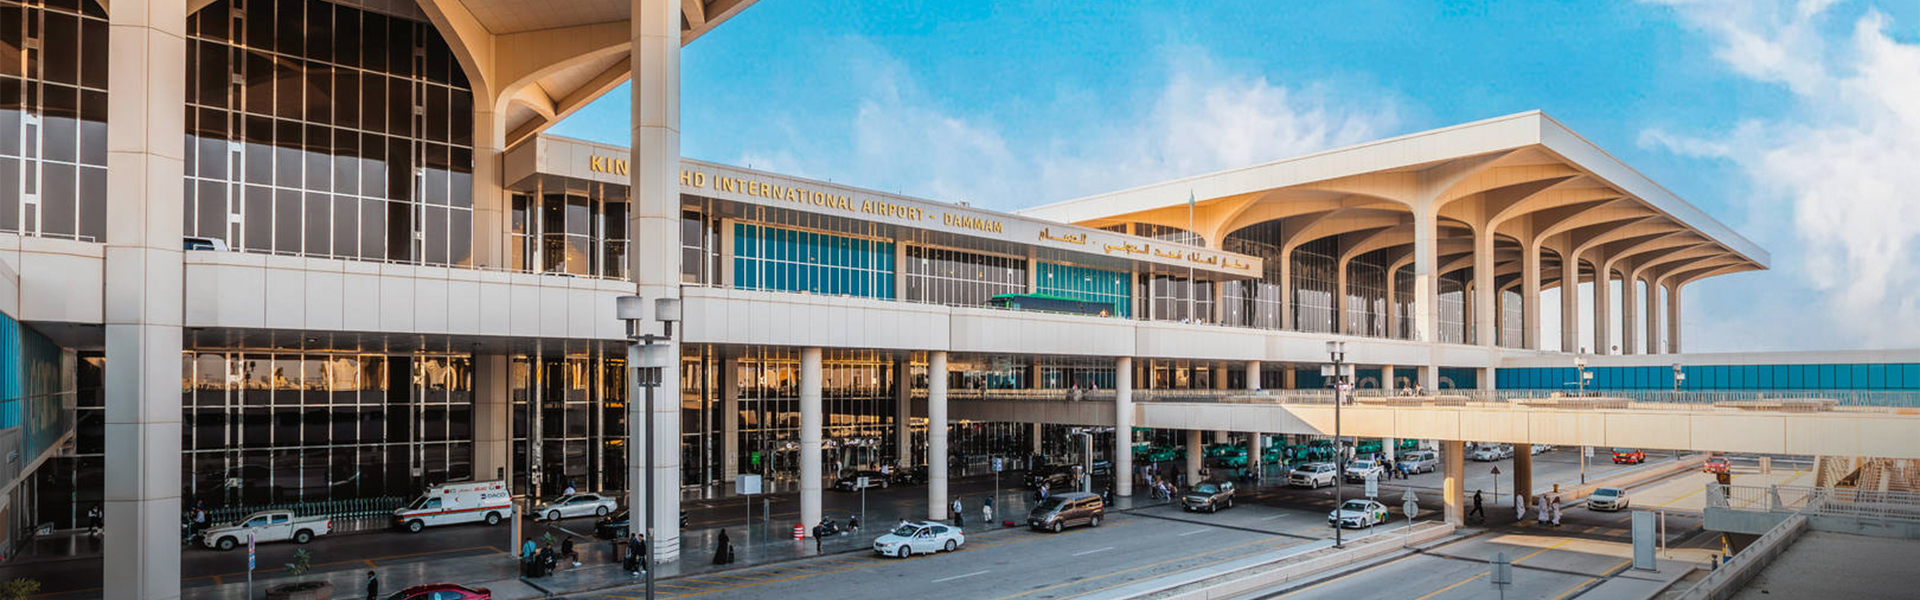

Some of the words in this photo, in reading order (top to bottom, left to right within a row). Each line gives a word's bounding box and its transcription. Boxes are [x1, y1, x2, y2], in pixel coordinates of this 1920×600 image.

[590, 155, 628, 175] KIN
[680, 170, 705, 188] HD
[714, 174, 856, 211] INTERNATIONAL
[861, 200, 924, 221] AIRPORT
[943, 212, 1003, 233] DAMMAM
